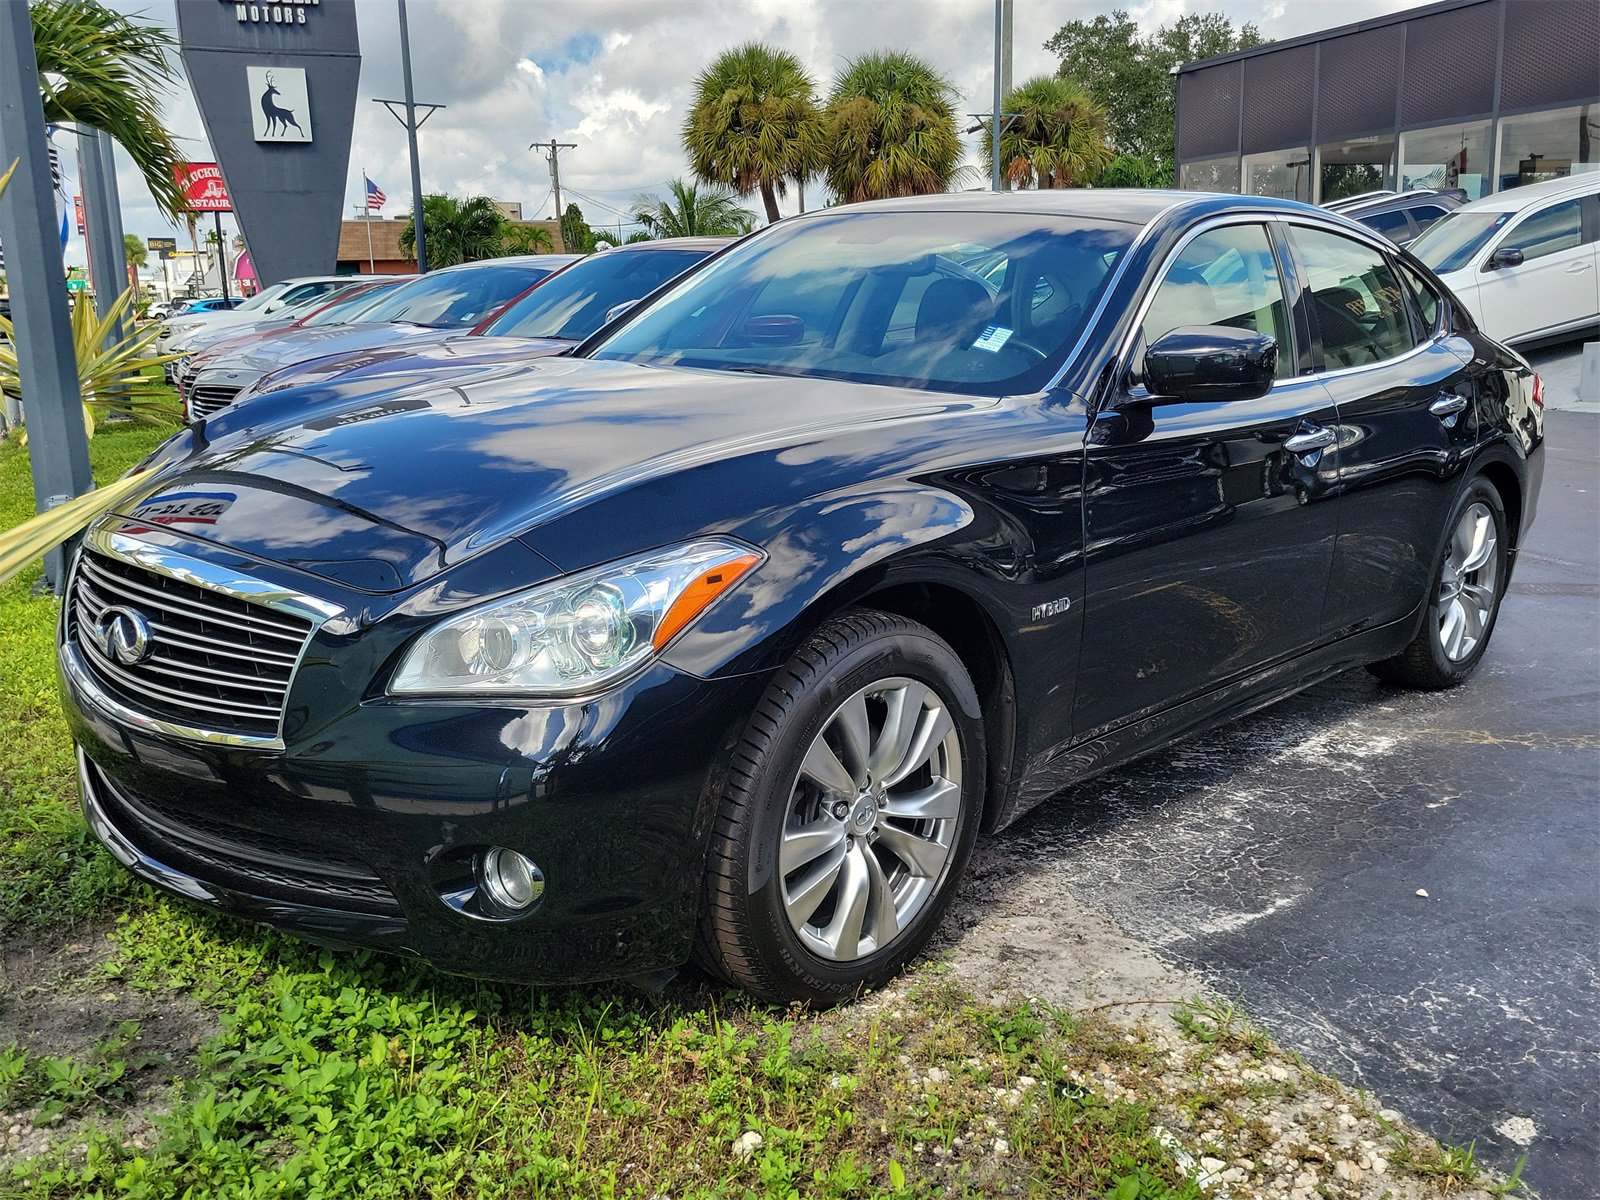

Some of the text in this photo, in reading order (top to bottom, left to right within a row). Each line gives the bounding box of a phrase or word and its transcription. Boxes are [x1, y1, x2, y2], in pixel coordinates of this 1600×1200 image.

[236, 5, 306, 23] MOTORS
[184, 199, 231, 208] ESTAUR
[1031, 597, 1070, 621] HYBRID
